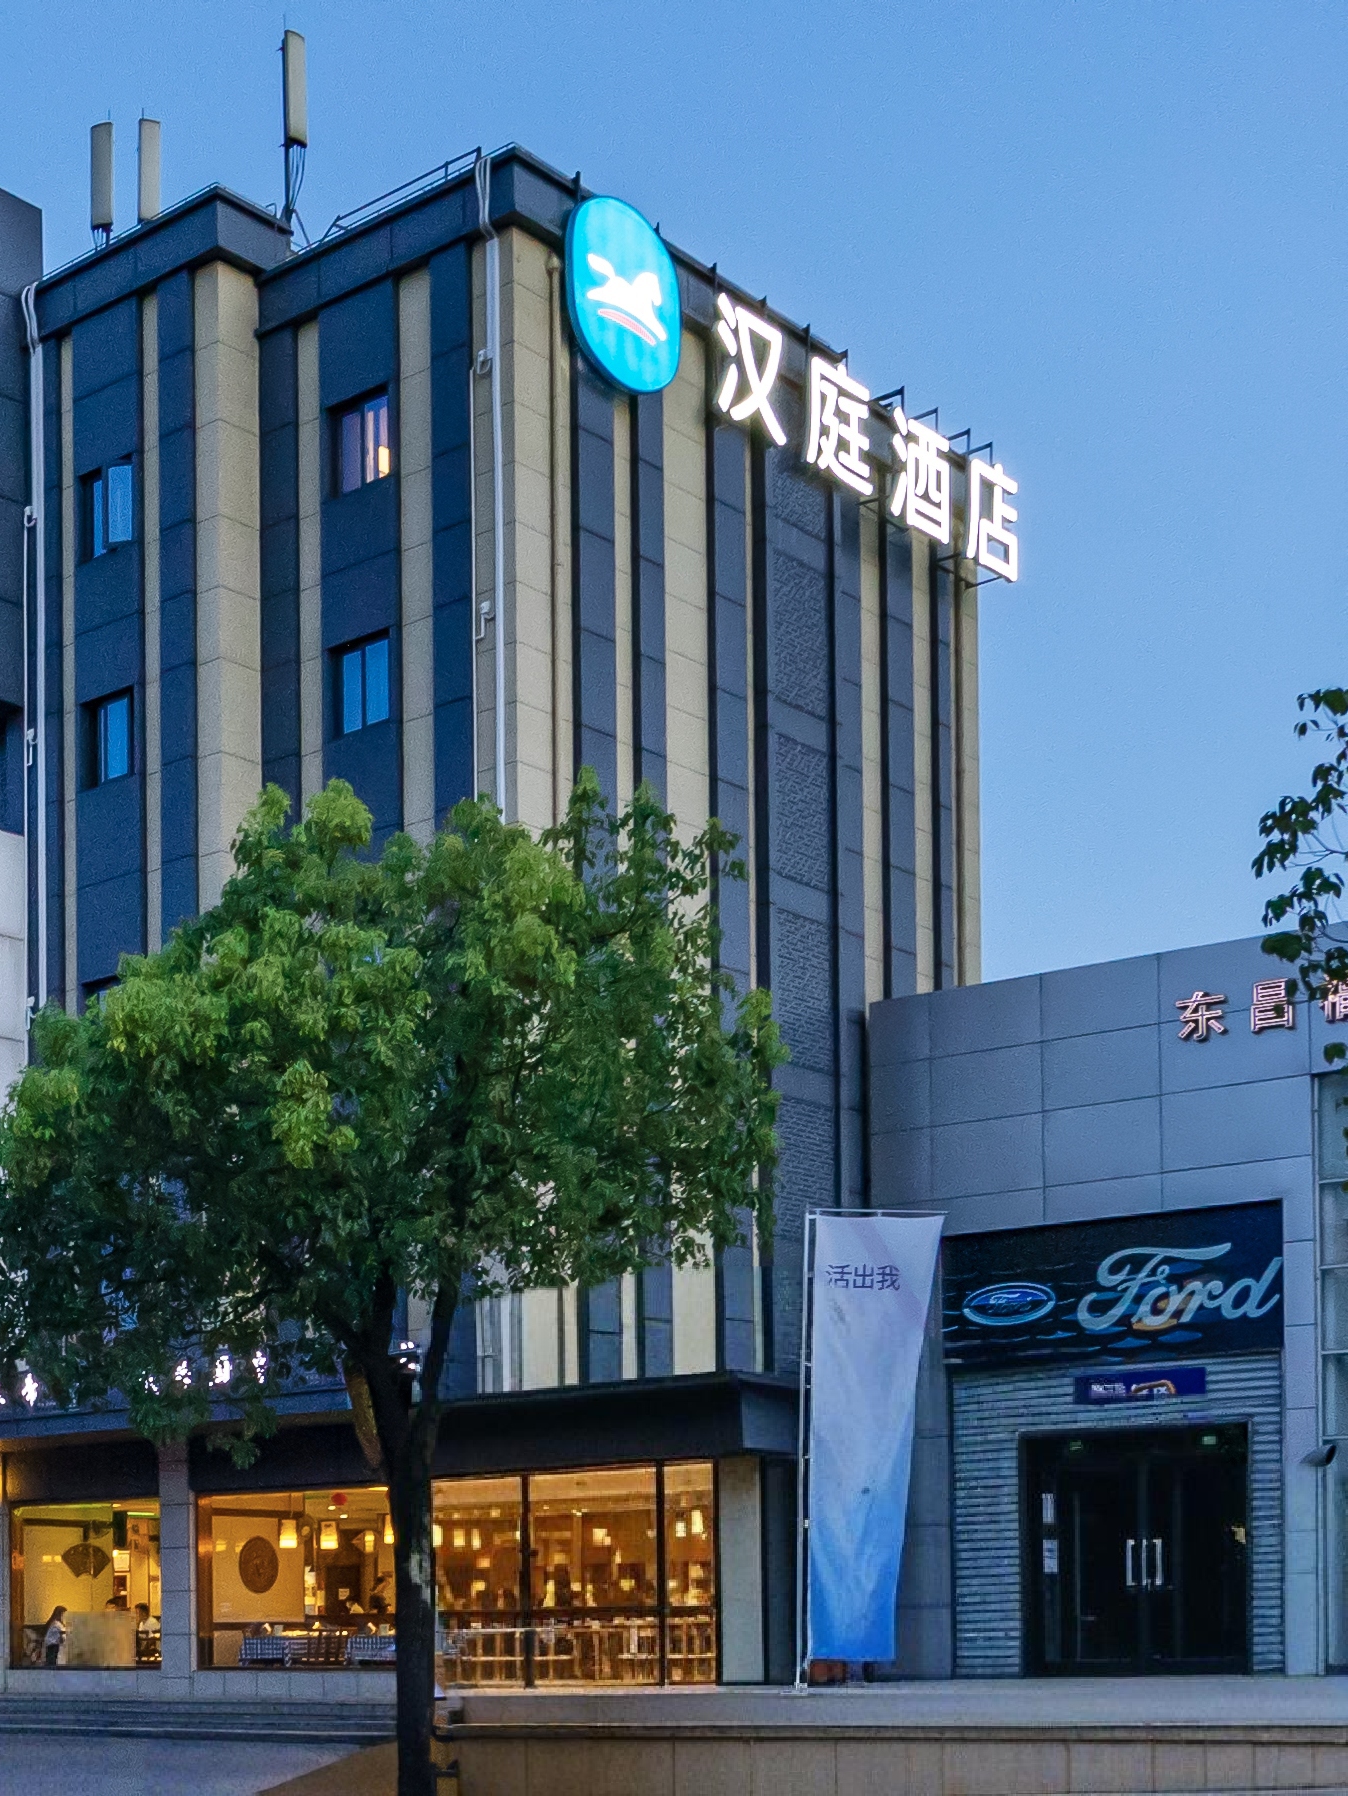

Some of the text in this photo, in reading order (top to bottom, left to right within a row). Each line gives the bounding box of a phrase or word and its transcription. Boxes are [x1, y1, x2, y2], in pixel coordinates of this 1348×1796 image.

[717, 292, 1018, 583] 汉庭酒店
[825, 1263, 901, 1291] 活出我
[1076, 1242, 1284, 1331] Ford
